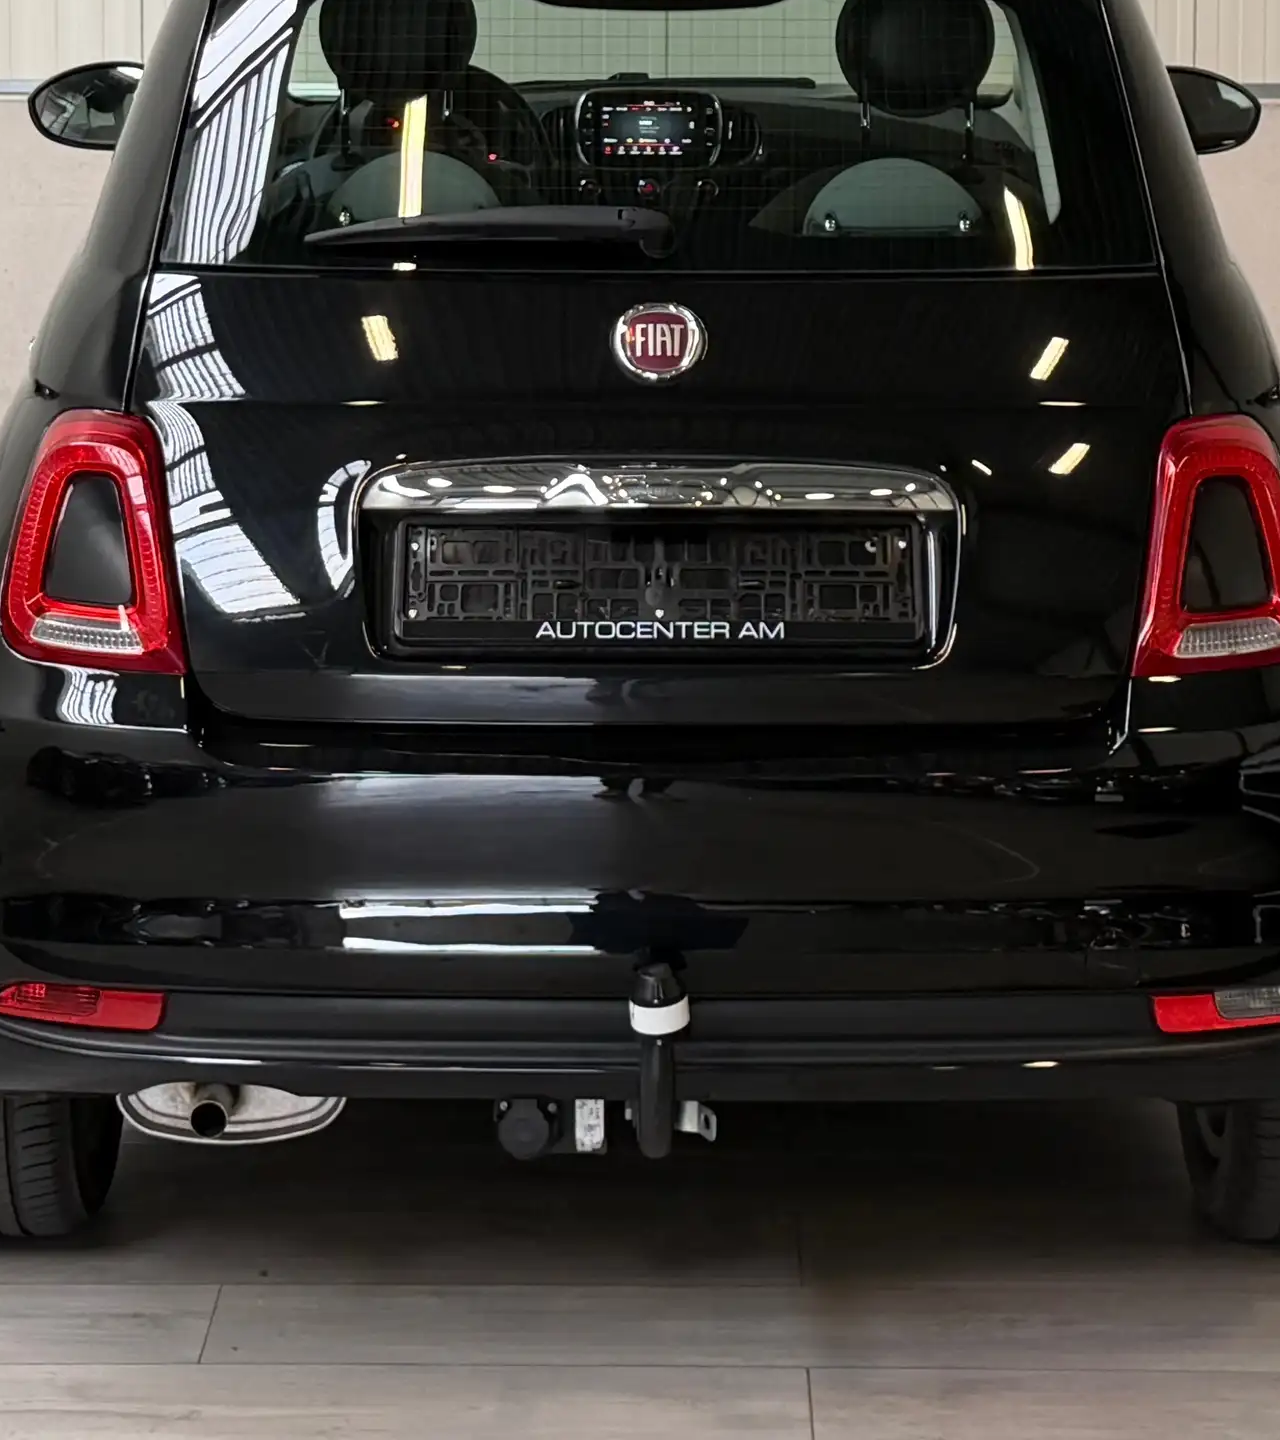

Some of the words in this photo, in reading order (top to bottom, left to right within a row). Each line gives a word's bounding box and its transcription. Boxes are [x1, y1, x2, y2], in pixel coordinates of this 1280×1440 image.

[634, 323, 685, 357] FIAT
[535, 620, 730, 640] AUTOCENTER
[737, 620, 785, 640] AM
